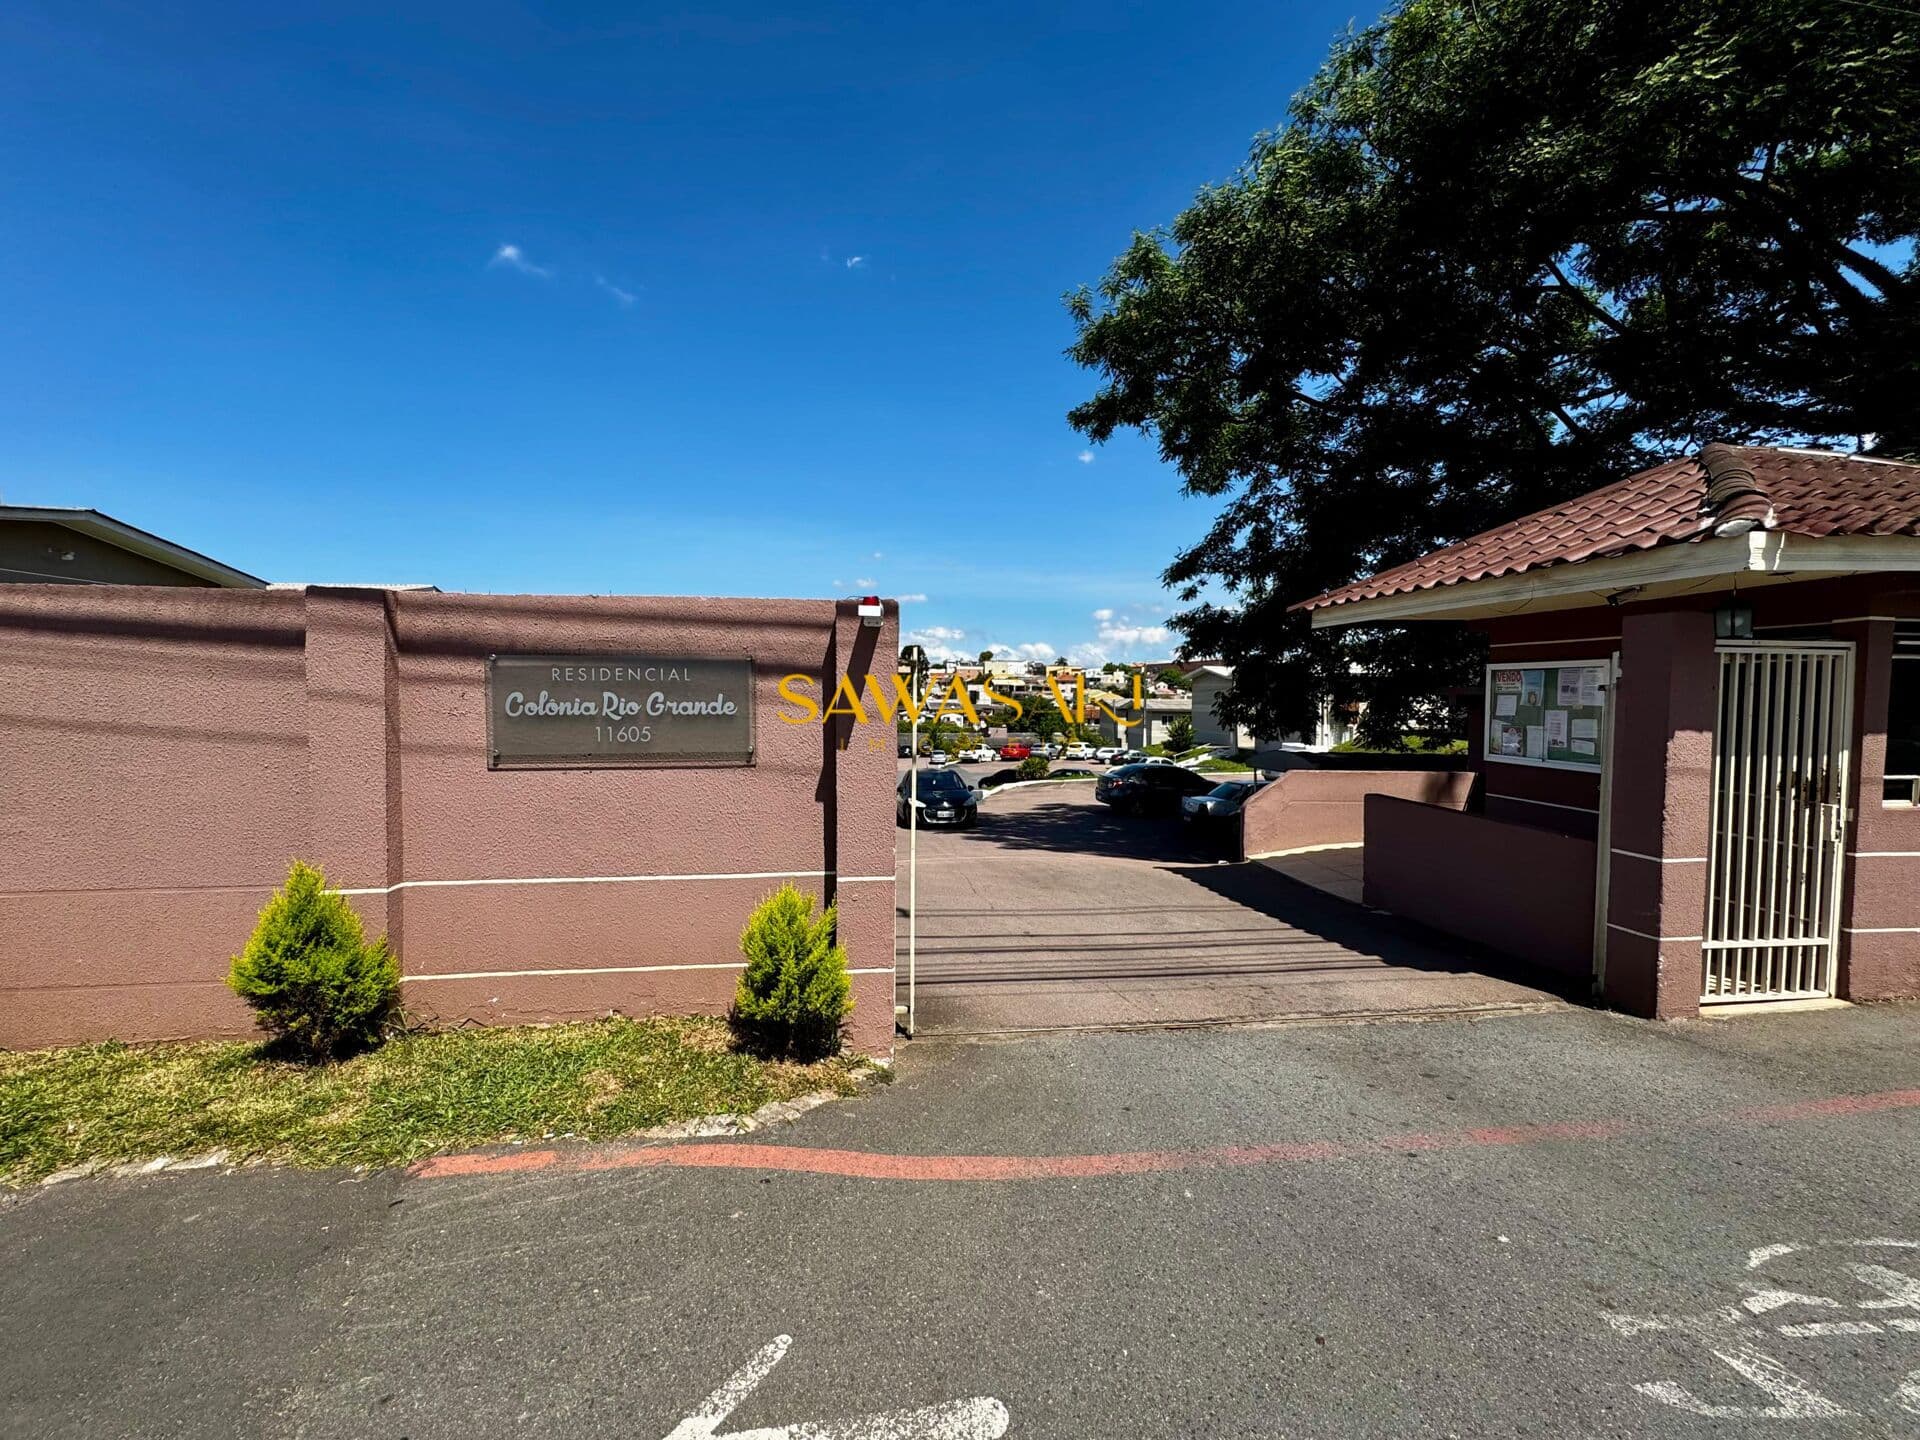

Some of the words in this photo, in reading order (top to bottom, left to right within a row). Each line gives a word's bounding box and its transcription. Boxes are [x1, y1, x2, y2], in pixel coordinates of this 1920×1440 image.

[551, 667, 691, 681] RESIDENCIAL
[504, 690, 599, 717] Colônia
[602, 691, 640, 721] Rio
[646, 691, 738, 716] Grande
[595, 726, 651, 742] 11605
